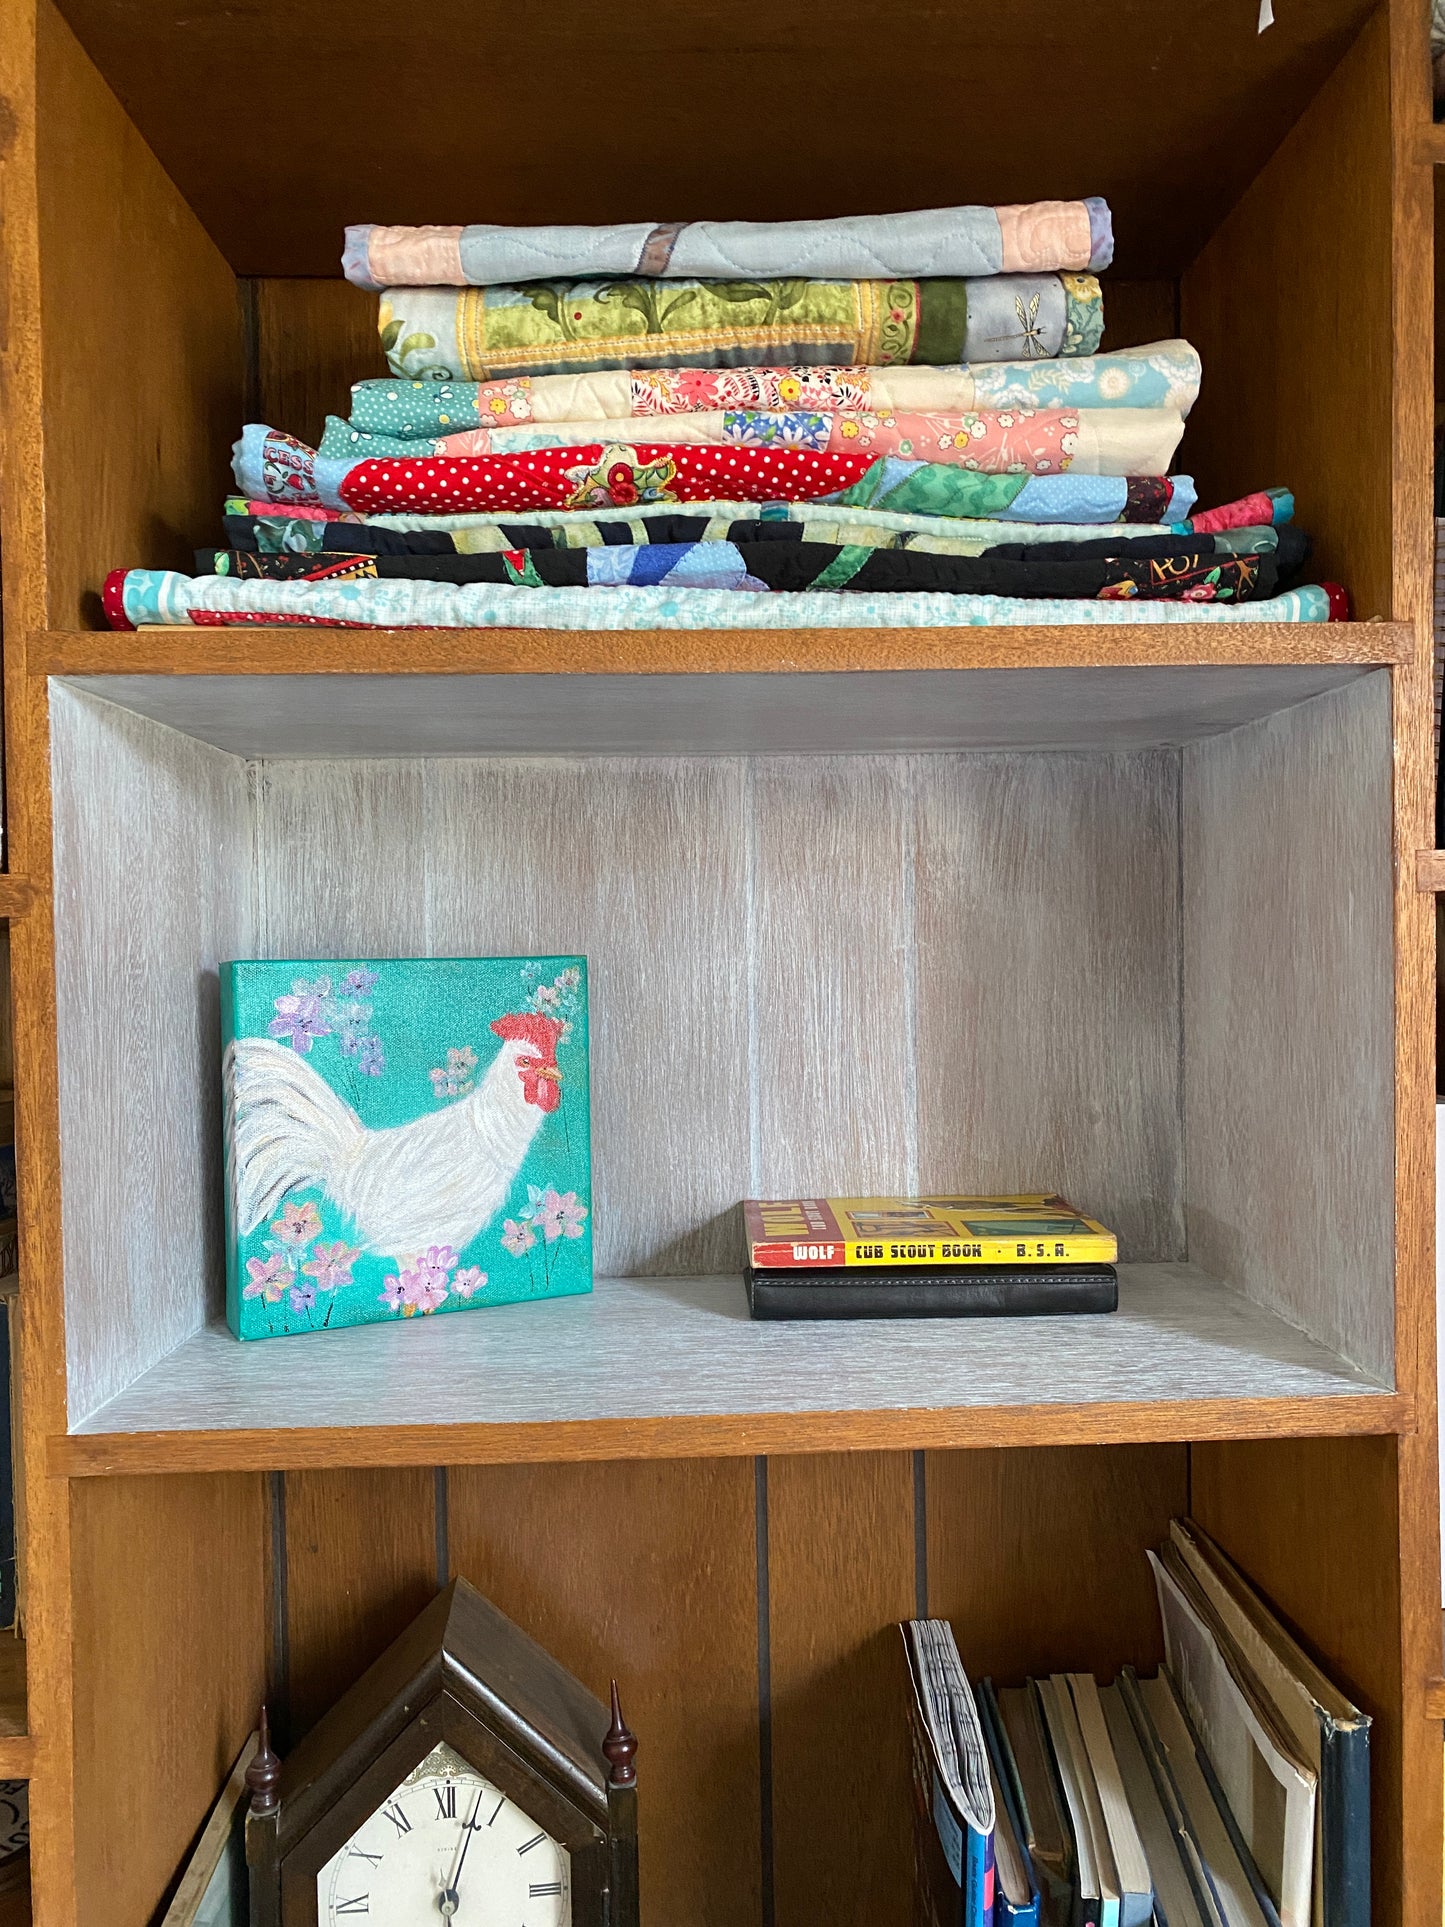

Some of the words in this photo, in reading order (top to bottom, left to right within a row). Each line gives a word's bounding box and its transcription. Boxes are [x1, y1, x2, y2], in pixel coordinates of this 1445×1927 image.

[758, 1202, 810, 1236] WOLF
[793, 1245, 834, 1260] WOLF
[856, 1245, 884, 1258] CUB
[891, 1244, 936, 1258] SCOUT
[942, 1244, 982, 1257] BOOK
[432, 1786, 457, 1821] XII
[380, 1802, 414, 1840] XI
[347, 1843, 384, 1869] X
[516, 1832, 548, 1857] II
[529, 1881, 561, 1898] III
[336, 1892, 369, 1916] IX
